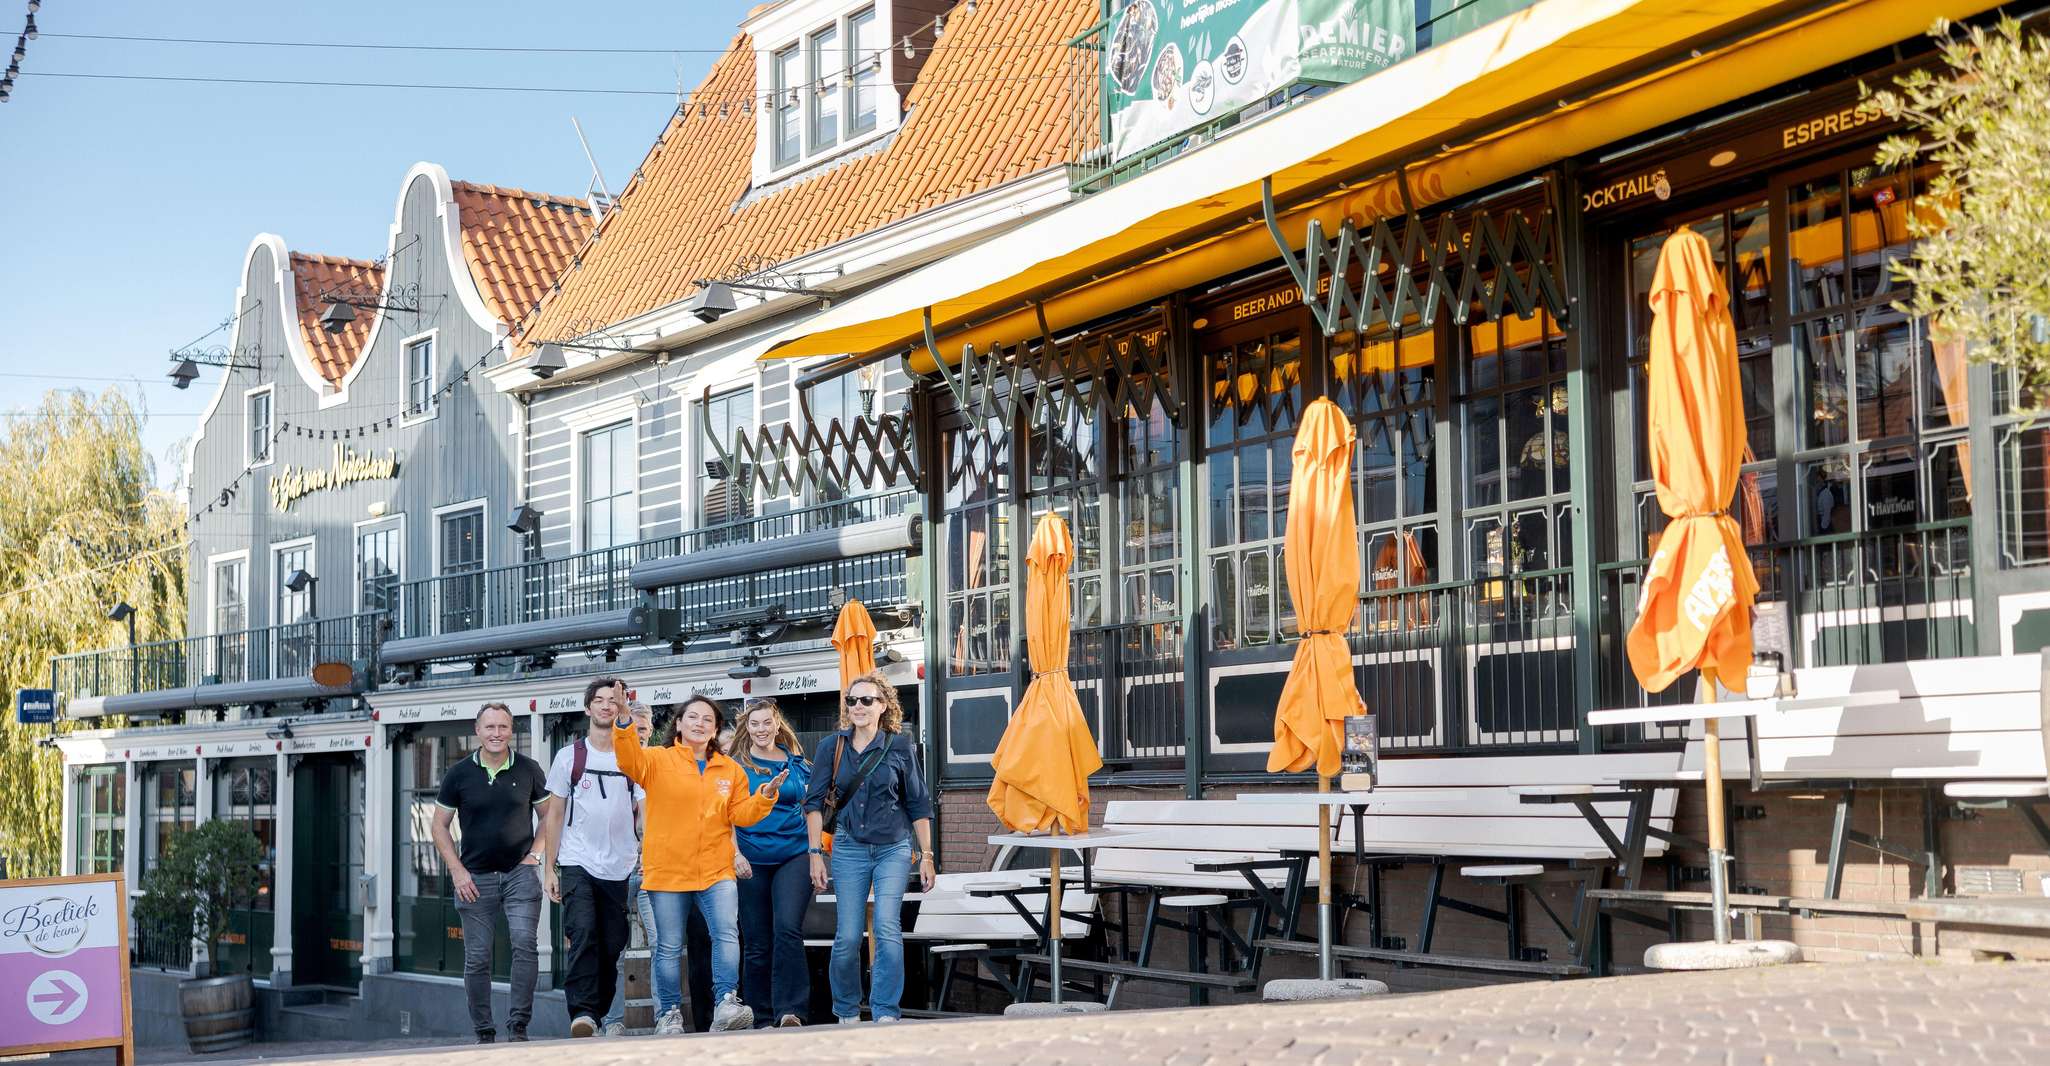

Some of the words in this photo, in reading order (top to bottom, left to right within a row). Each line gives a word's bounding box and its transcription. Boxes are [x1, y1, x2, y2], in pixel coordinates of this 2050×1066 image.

[1783, 106, 1890, 149] ESPRESS
[1234, 299, 1265, 320] BEER
[1267, 290, 1294, 310] AND
[303, 467, 326, 493] van
[779, 678, 794, 691] Beer
[795, 675, 801, 689] &
[801, 673, 817, 689] Wine
[653, 687, 672, 701] Drinks
[35, 928, 50, 942] de
